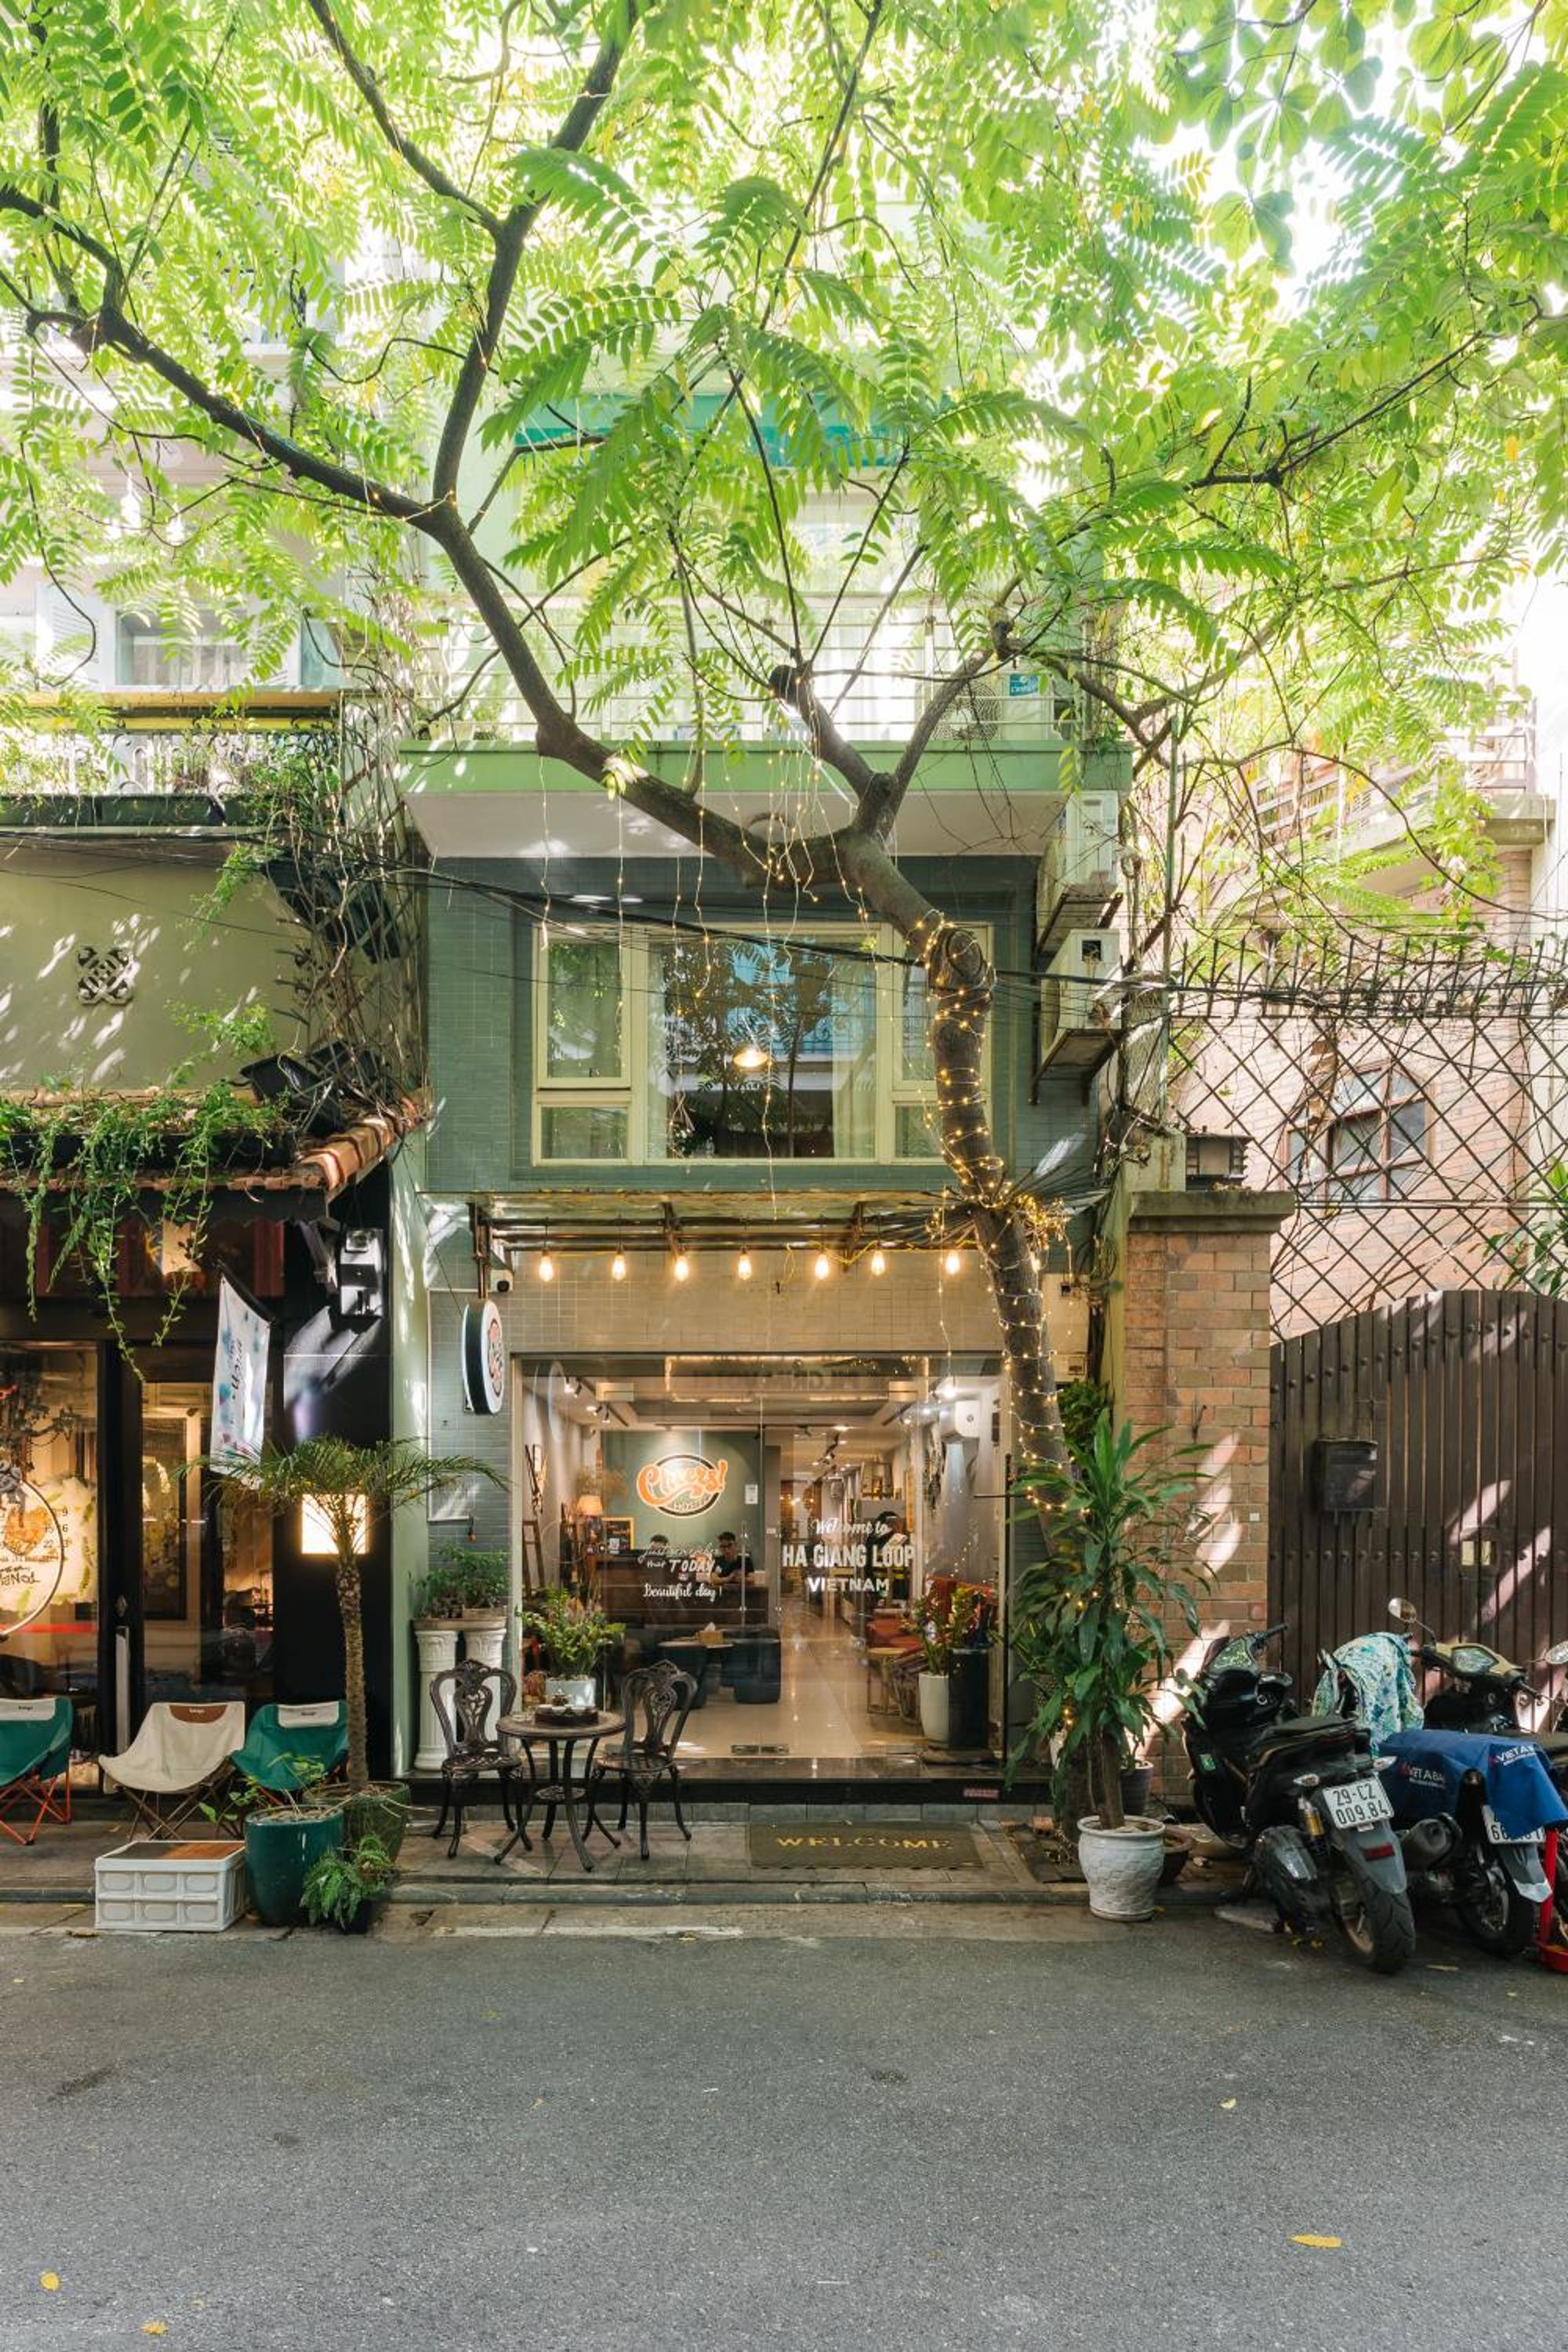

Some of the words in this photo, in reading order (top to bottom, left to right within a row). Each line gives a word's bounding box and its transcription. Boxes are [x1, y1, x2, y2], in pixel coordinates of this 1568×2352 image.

[636, 1459, 728, 1506] Cheers!
[782, 1544, 808, 1567] HA
[813, 1544, 866, 1567] GIANG
[872, 1544, 916, 1567] LOOP
[643, 1582, 693, 1600] Beautiful
[808, 1577, 890, 1593] VIETNAM
[1335, 1799, 1389, 1824] 009.84
[777, 1836, 954, 1849] WELCOME
